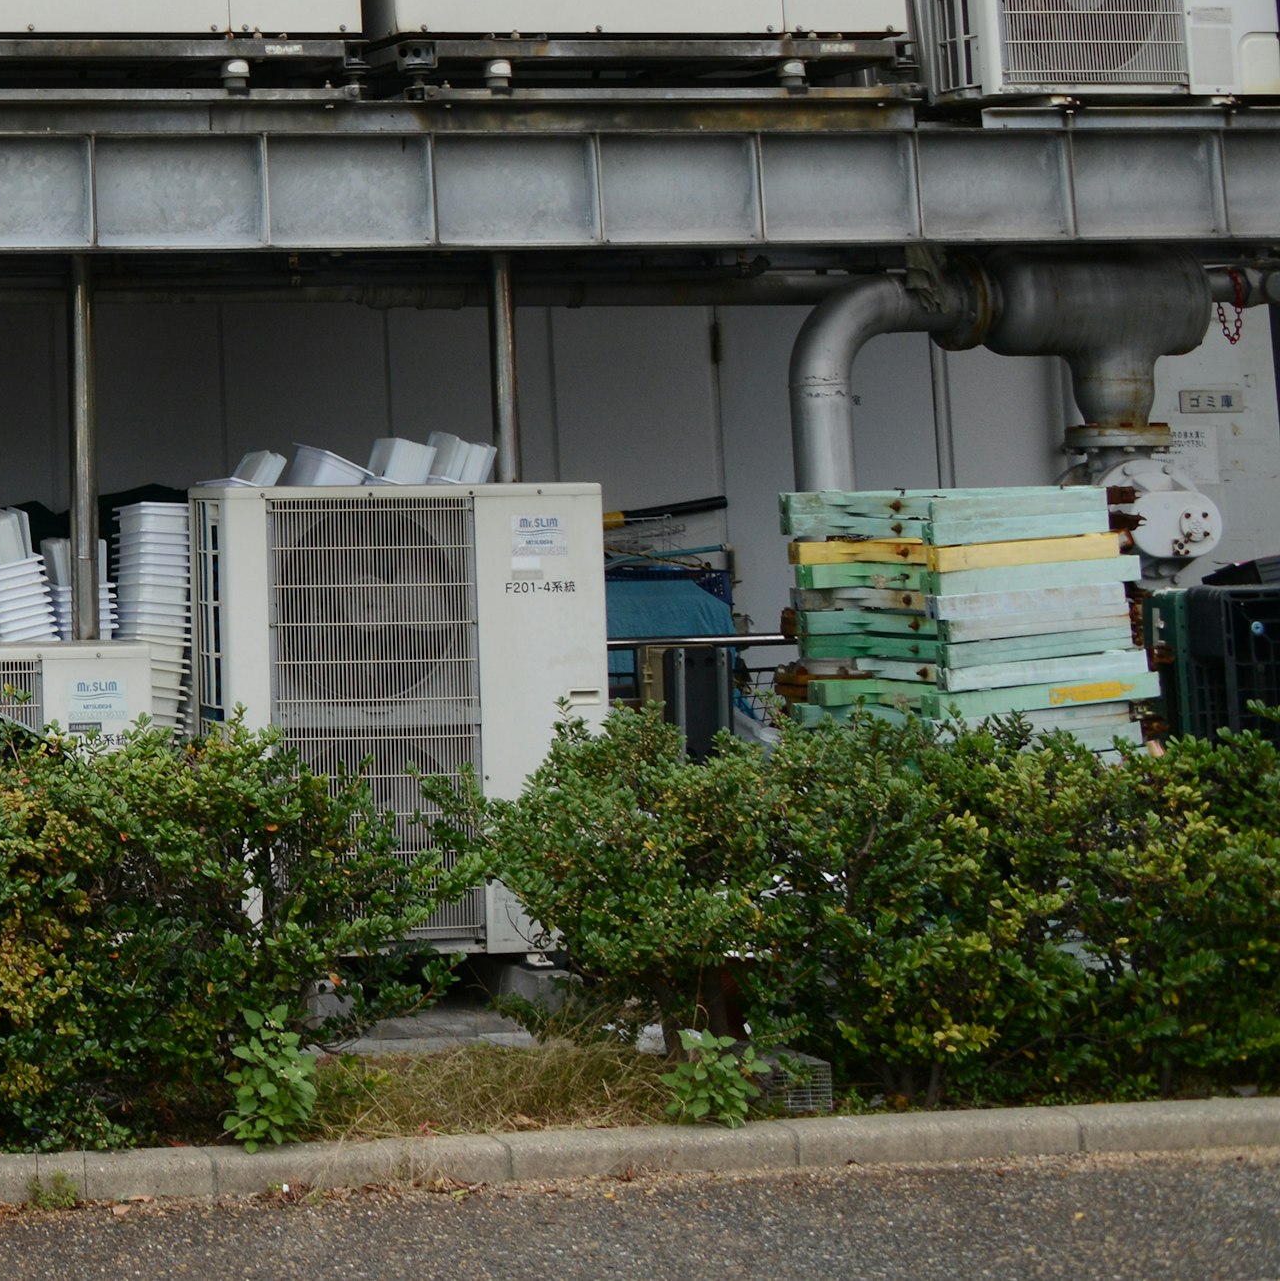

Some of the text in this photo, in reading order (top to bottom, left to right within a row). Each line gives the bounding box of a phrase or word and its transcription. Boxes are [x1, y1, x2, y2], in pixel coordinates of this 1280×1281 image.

[1190, 395, 1233, 408] ゴミ庫
[519, 517, 558, 528] Mr.SLIM
[505, 580, 576, 594] F201-4系統
[76, 681, 118, 692] Mr.SLIM
